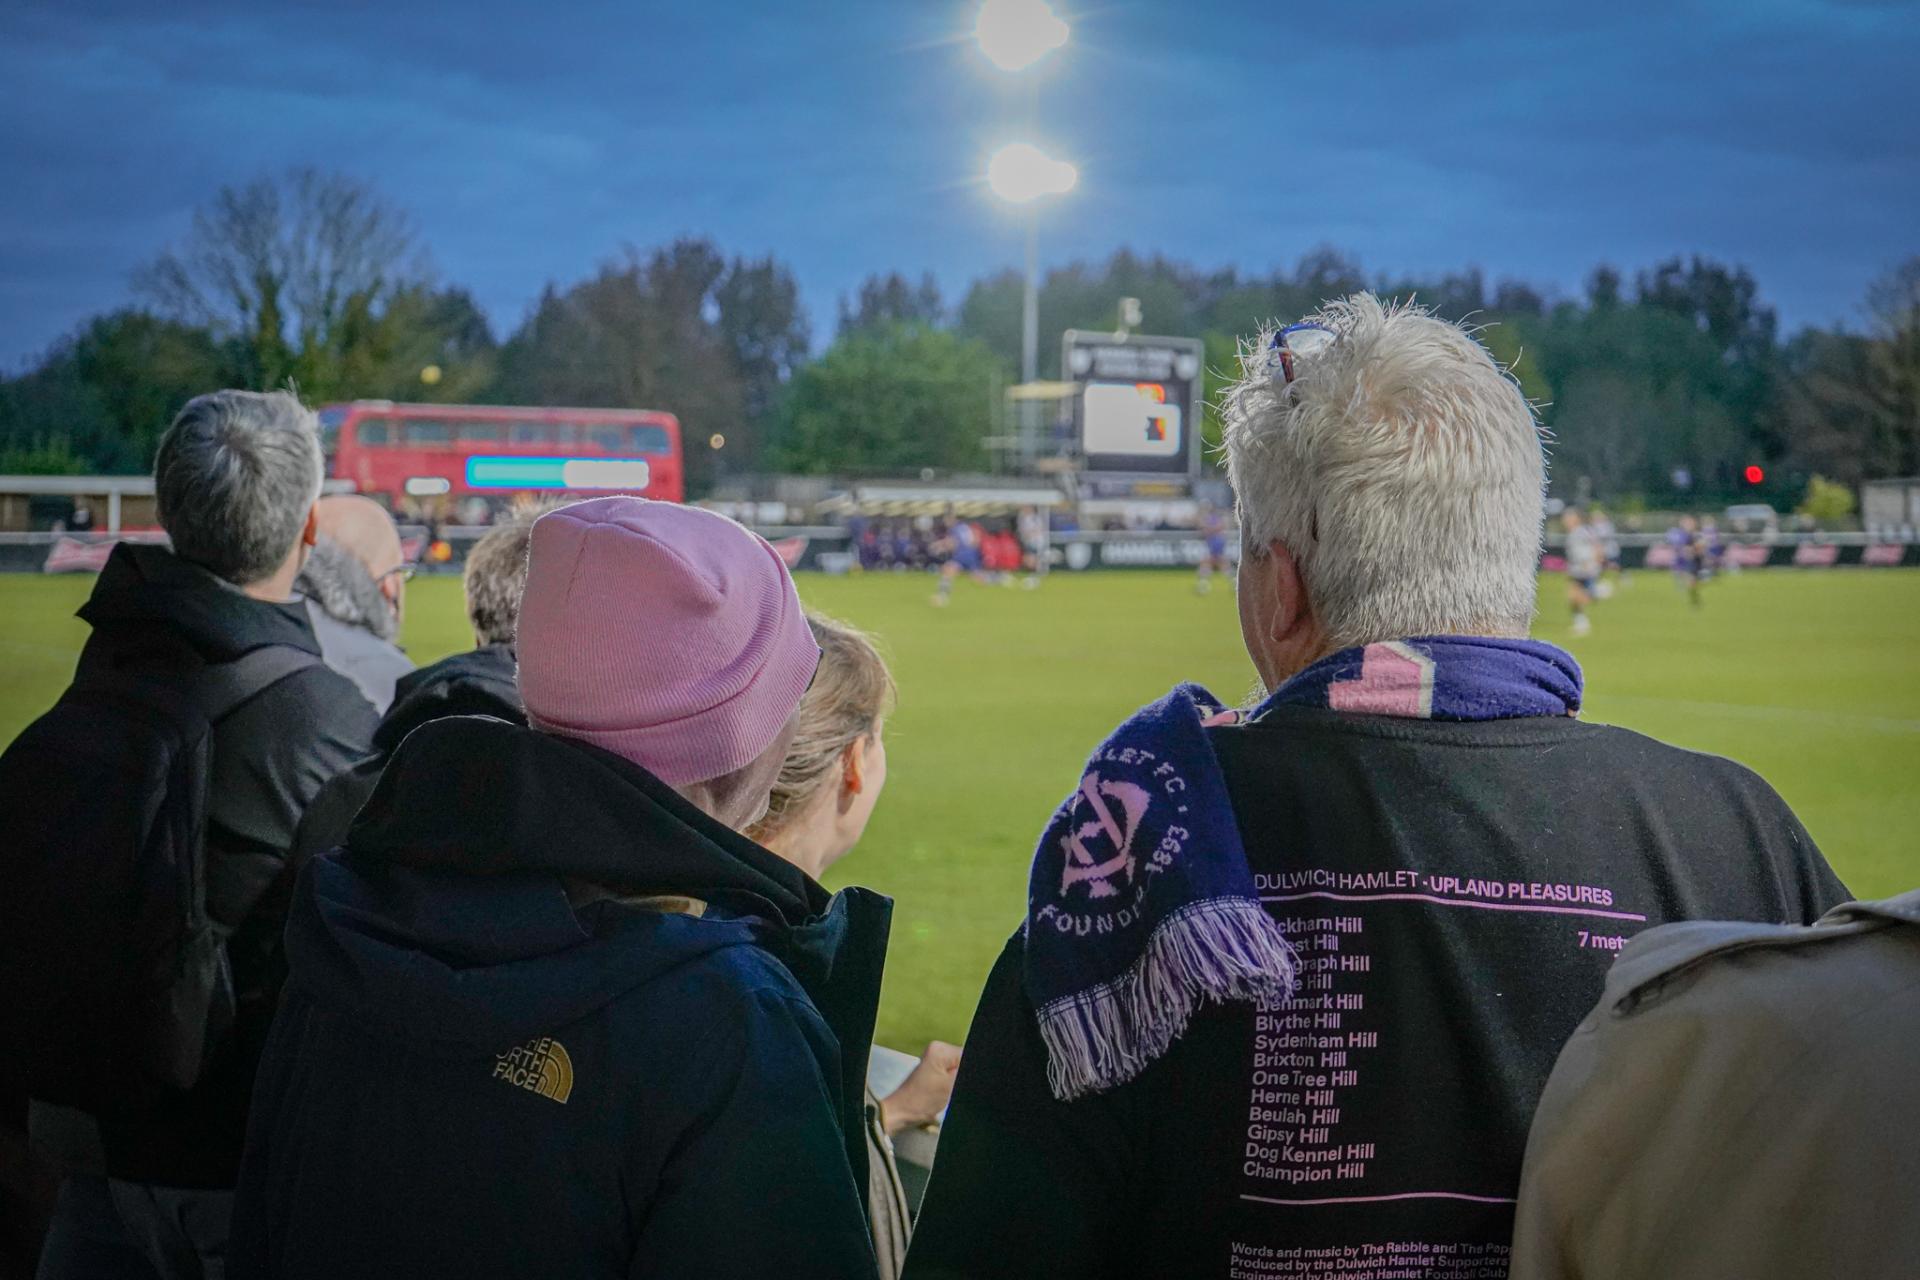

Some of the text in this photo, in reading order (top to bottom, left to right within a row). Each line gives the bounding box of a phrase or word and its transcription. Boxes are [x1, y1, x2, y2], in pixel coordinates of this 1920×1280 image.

[1144, 824, 1190, 874] 1893
[1254, 869, 1336, 890] DULWICH
[1339, 870, 1419, 889] HAMLET
[1430, 875, 1505, 898] UPLAND
[1508, 882, 1614, 906] PLEASURES
[1335, 916, 1363, 933] Hill
[1314, 934, 1339, 951] Hill
[1577, 930, 1589, 948] 7
[1341, 955, 1371, 972] Hill
[1307, 973, 1333, 990] Hill
[1256, 993, 1364, 1013] Denmark Hill
[1255, 1013, 1342, 1033] Blythe Hill
[1254, 1031, 1378, 1051] Sydenham Hill
[1253, 1051, 1347, 1068] Brixton Hill
[491, 1060, 540, 1091] FACE
[1252, 1070, 1358, 1087] One Tree Hill
[1250, 1088, 1334, 1106] Herne Hill
[1249, 1106, 1341, 1125] Beulah Hill
[1247, 1124, 1330, 1146] Gipsy Hill
[1245, 1142, 1376, 1164] Dog Kennel Hill
[1243, 1161, 1365, 1185] Champion Hill
[1231, 1241, 1274, 1258] Words
[1276, 1247, 1302, 1259] and
[1304, 1245, 1342, 1258] music
[1343, 1245, 1359, 1259] by
[1361, 1243, 1385, 1256] The
[1386, 1241, 1430, 1254] Rabble
[1432, 1242, 1457, 1254] and
[1460, 1243, 1483, 1255] The
[1230, 1254, 1293, 1271] Produced
[1295, 1260, 1312, 1272] by
[1313, 1259, 1334, 1270] the
[1336, 1256, 1386, 1270] Dulwich
[1388, 1254, 1436, 1267] Hamlet
[1230, 1267, 1304, 1280] Engineered
[1324, 1270, 1374, 1280] Dulwich
[1376, 1267, 1422, 1280] Hamlet
[1425, 1268, 1476, 1280] Football
[1478, 1267, 1507, 1280] Club
